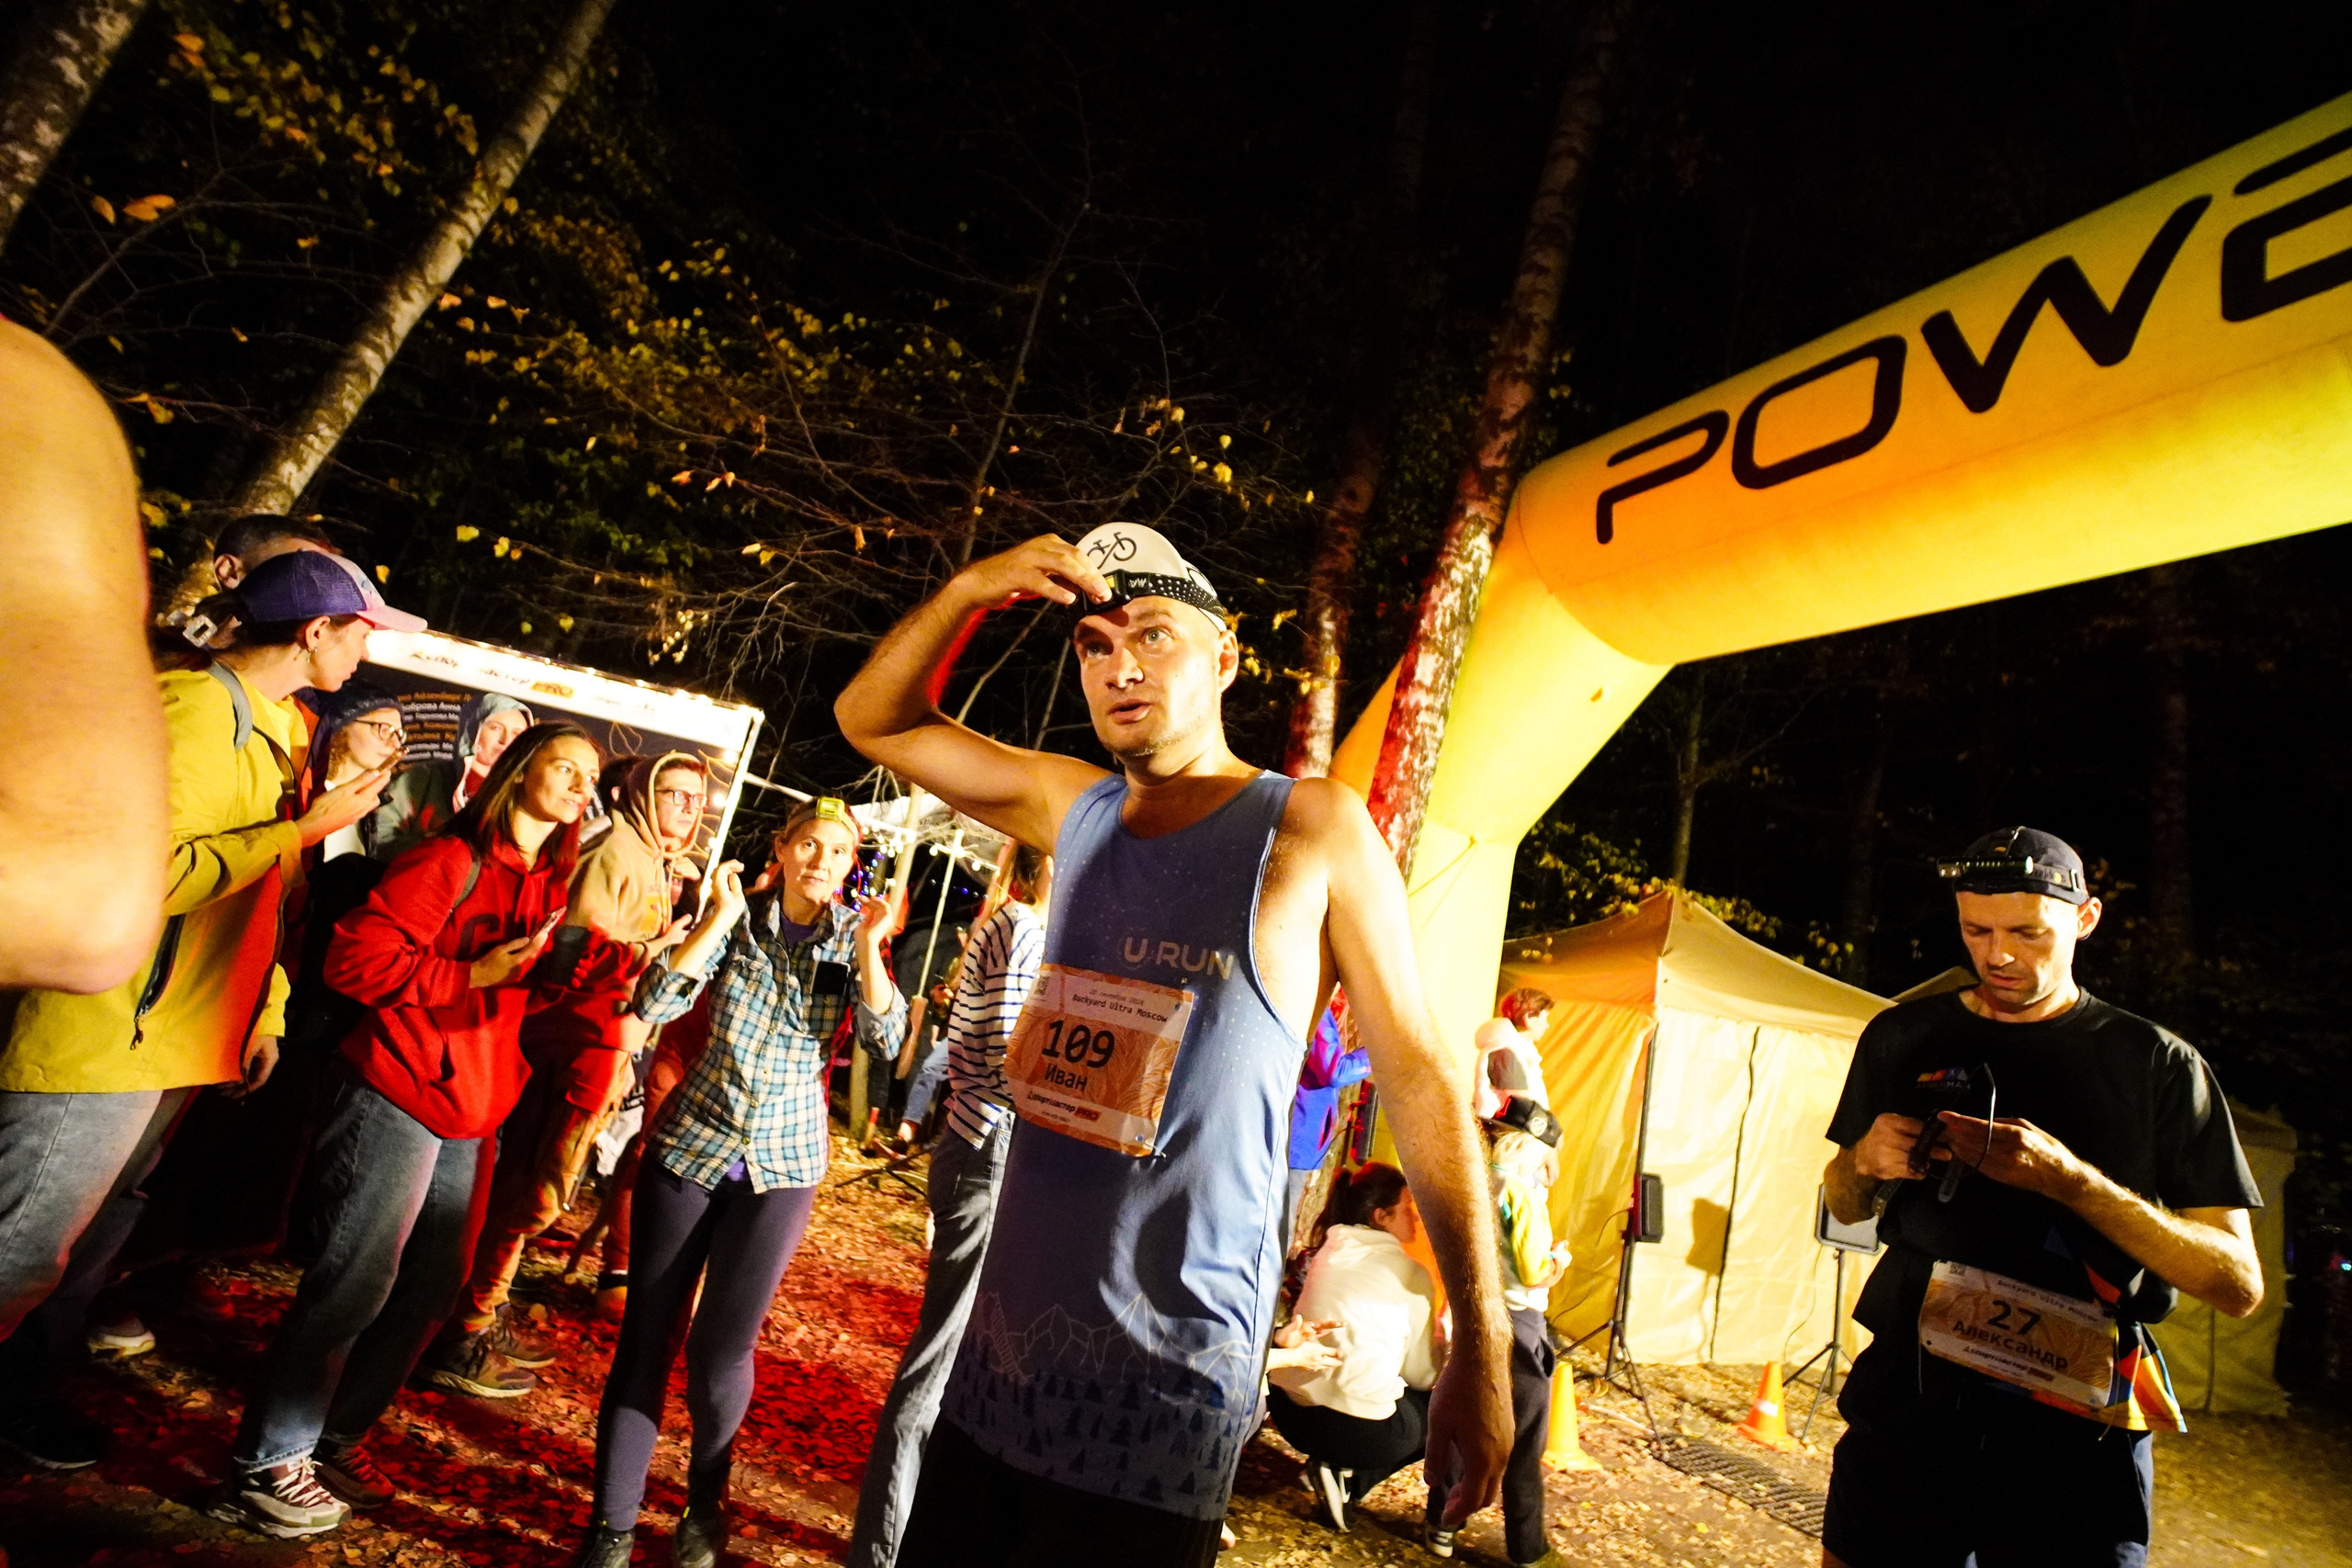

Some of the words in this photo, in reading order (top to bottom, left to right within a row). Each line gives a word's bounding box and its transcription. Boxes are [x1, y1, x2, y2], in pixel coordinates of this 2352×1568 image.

[1123, 936, 1148, 964] U
[1156, 940, 1235, 981] RUN
[1072, 993, 1106, 1009] Backyard
[1109, 1000, 1133, 1015] Ultra
[1136, 1008, 1169, 1023] Moscow
[1041, 1019, 1115, 1068] 109
[1044, 1062, 1088, 1092] Иван
[1987, 1299, 2041, 1335] 27
[1952, 1320, 2069, 1371] Александр
